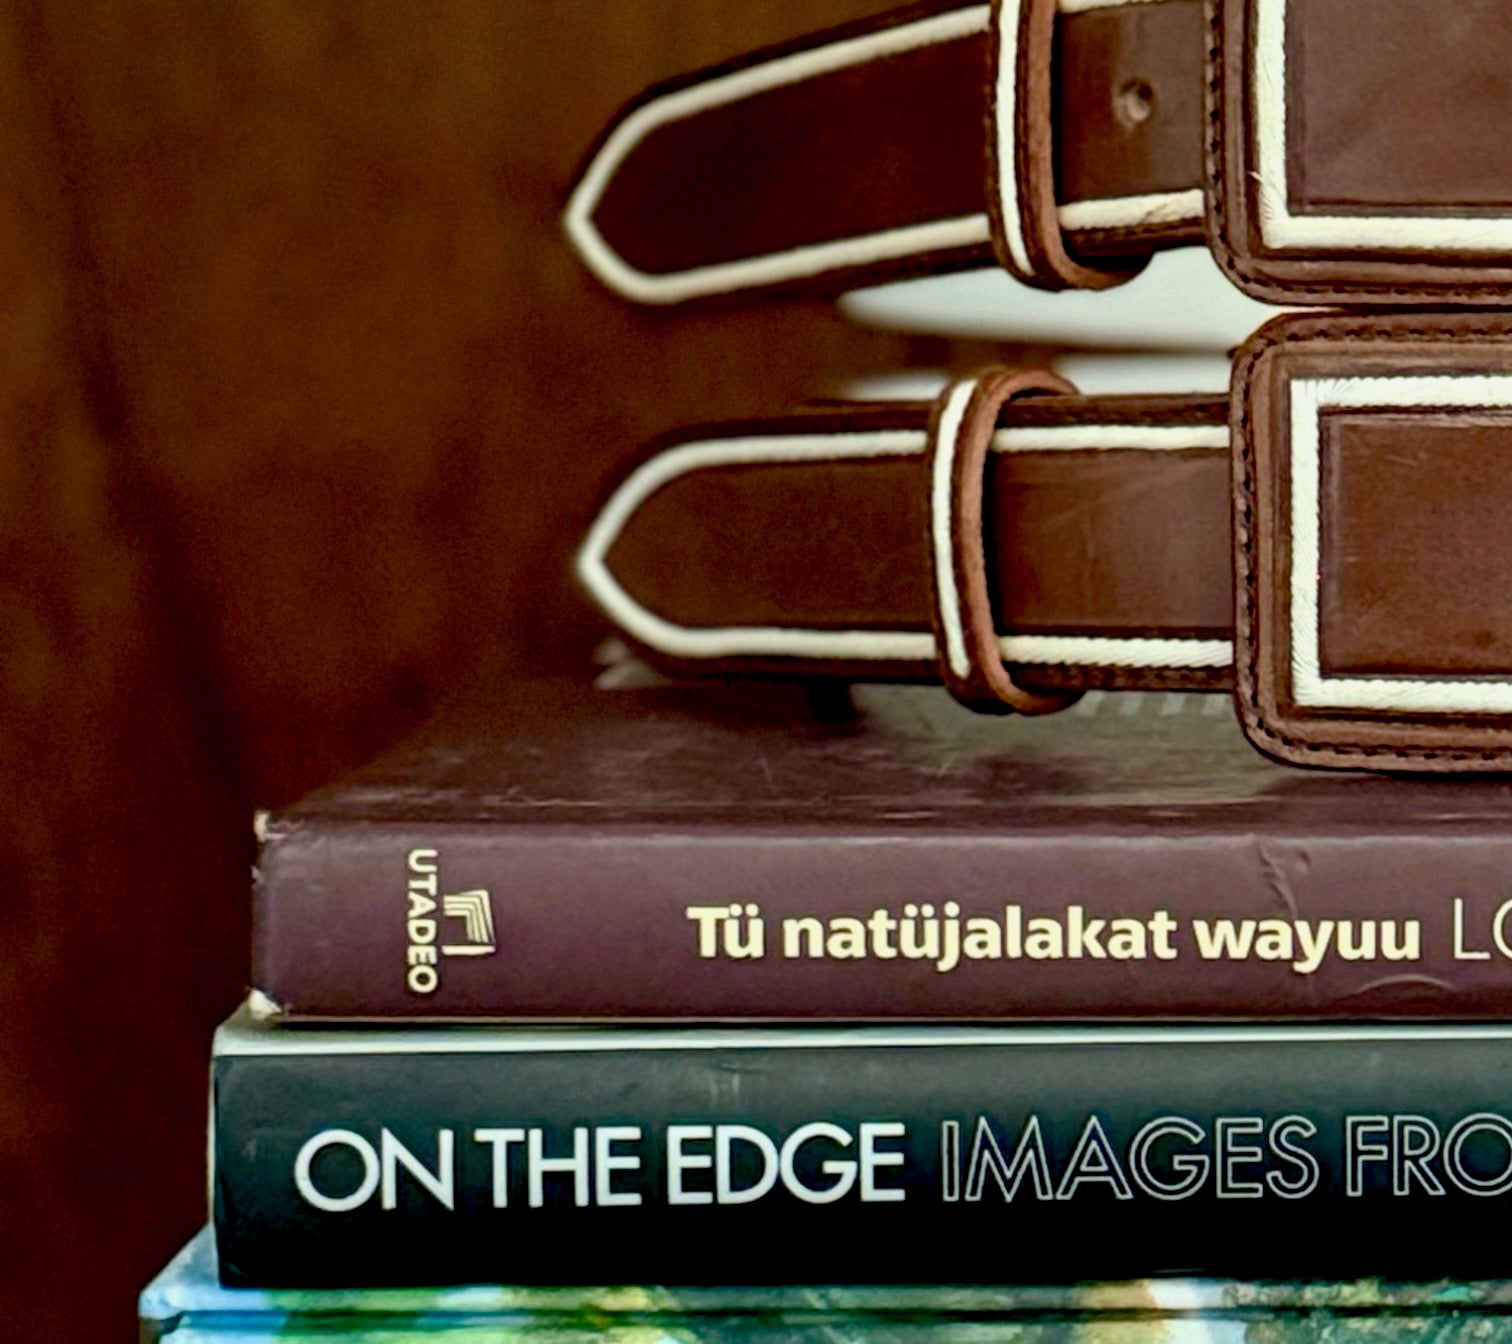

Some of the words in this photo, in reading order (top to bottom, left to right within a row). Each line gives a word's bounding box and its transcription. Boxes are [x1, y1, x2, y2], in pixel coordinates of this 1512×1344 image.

[408, 848, 439, 994] UTADEO
[685, 902, 765, 959] Tü
[782, 899, 1177, 972] natüjalakat
[1191, 915, 1420, 974] wayuu
[293, 1126, 455, 1212] ON
[474, 1125, 643, 1208] THE
[667, 1122, 906, 1205] EDGE
[940, 1114, 1320, 1204] IMAGES
